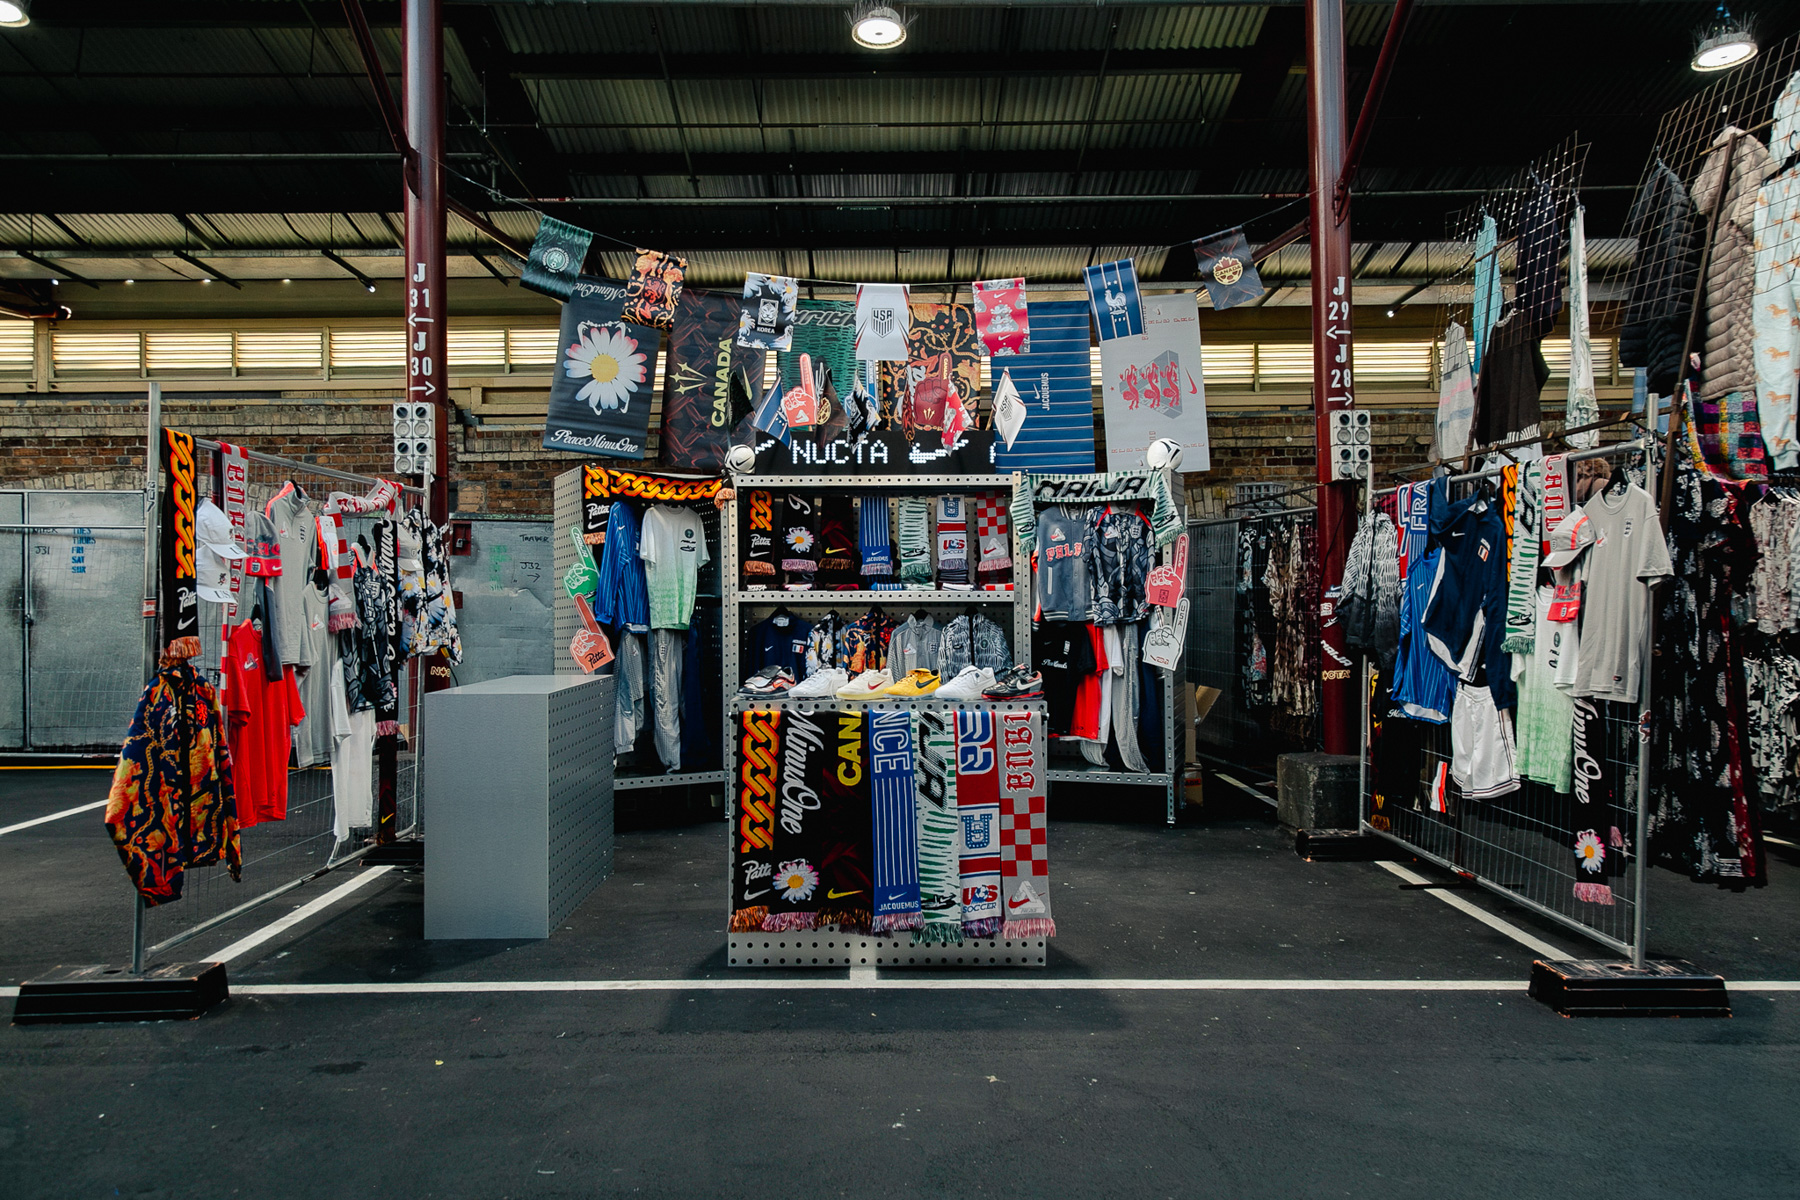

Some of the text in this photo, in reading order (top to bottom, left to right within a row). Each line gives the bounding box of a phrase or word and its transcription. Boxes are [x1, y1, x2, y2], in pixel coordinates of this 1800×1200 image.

[413, 263, 426, 282] J
[1214, 263, 1241, 276] CANADA
[1332, 276, 1346, 296] J
[409, 288, 430, 308] 31
[873, 309, 893, 321] USA
[1328, 301, 1349, 321] 29
[756, 326, 775, 334] KOREA
[413, 331, 427, 351] J
[1334, 344, 1347, 363] J
[411, 356, 432, 376] 30
[711, 338, 732, 427] CANADA
[1330, 368, 1351, 388] 28
[1040, 372, 1050, 411] JACQUEMUS
[35, 546, 50, 555] J31
[71, 546, 84, 554] FRI
[71, 556, 85, 564] SAT
[520, 562, 541, 570] J32
[1177, 605, 1186, 627] USA
[585, 649, 607, 668] Patta
[1320, 639, 1353, 667] NAIJA
[837, 711, 862, 786] CAN
[878, 901, 920, 912] JACQUEMUS
[962, 902, 997, 914] SOCCER
